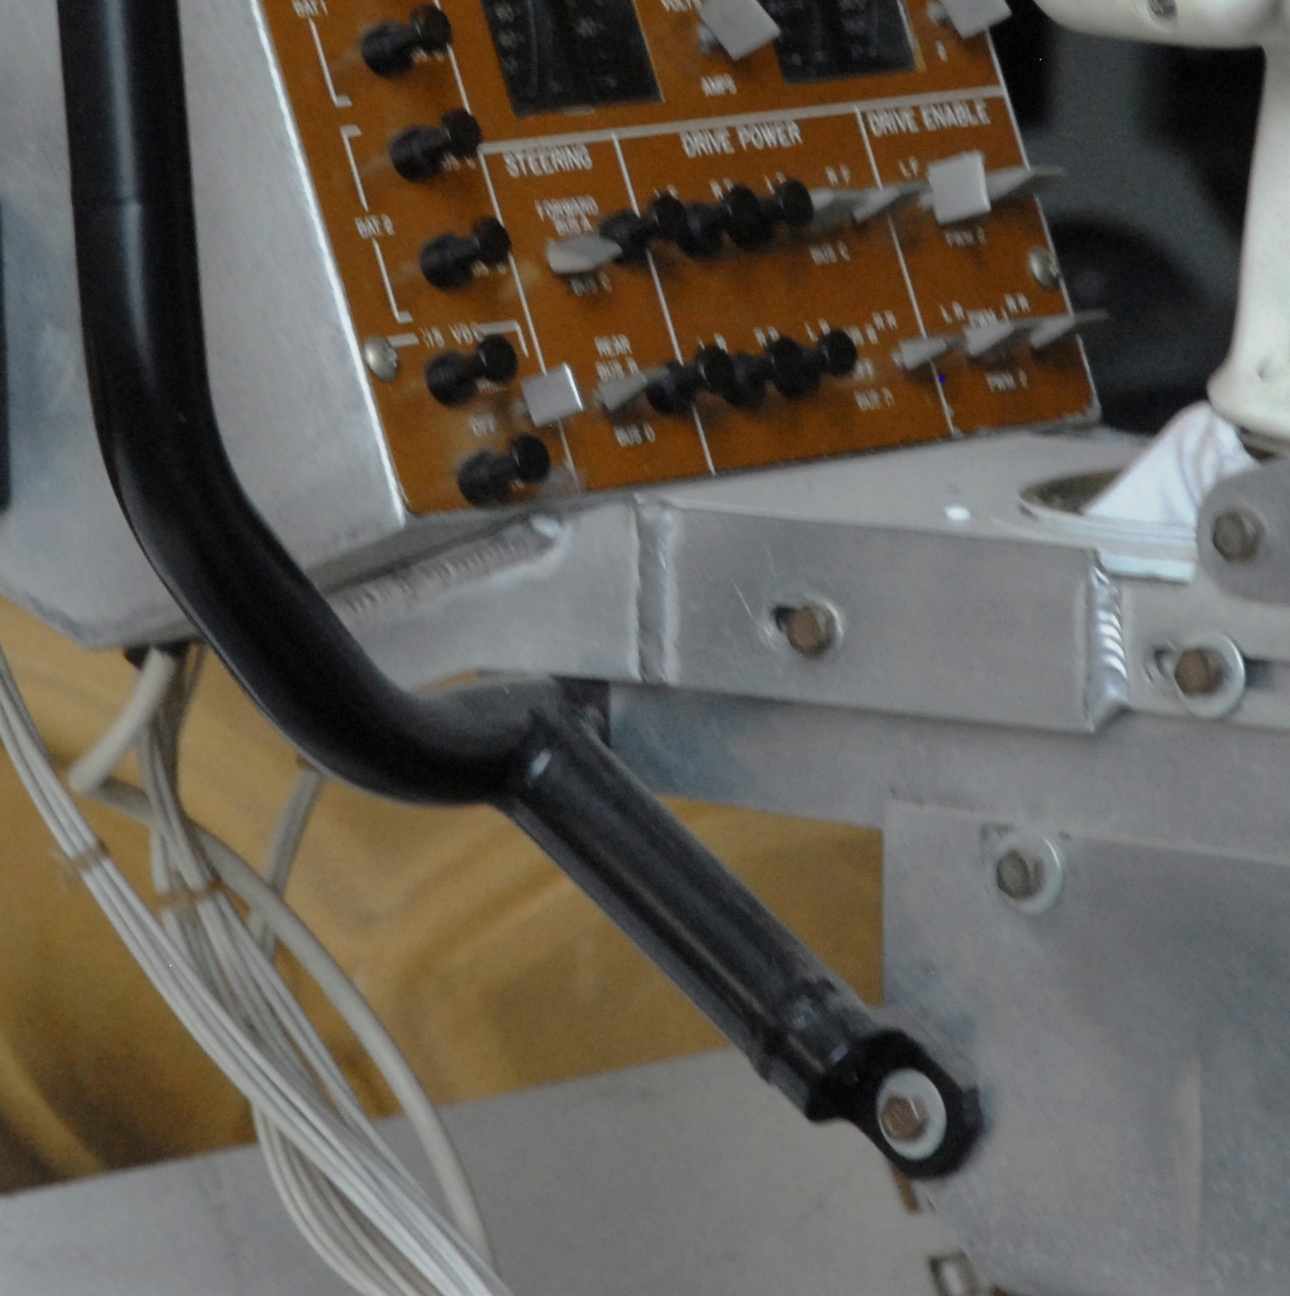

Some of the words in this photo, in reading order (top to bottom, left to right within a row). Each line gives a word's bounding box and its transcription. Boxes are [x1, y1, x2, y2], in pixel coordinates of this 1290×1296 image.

[866, 107, 919, 137] DRIVE
[919, 98, 992, 130] ENABLE
[679, 127, 735, 158] DRIVE
[736, 120, 803, 150] POWER
[502, 143, 593, 178] STEERING
